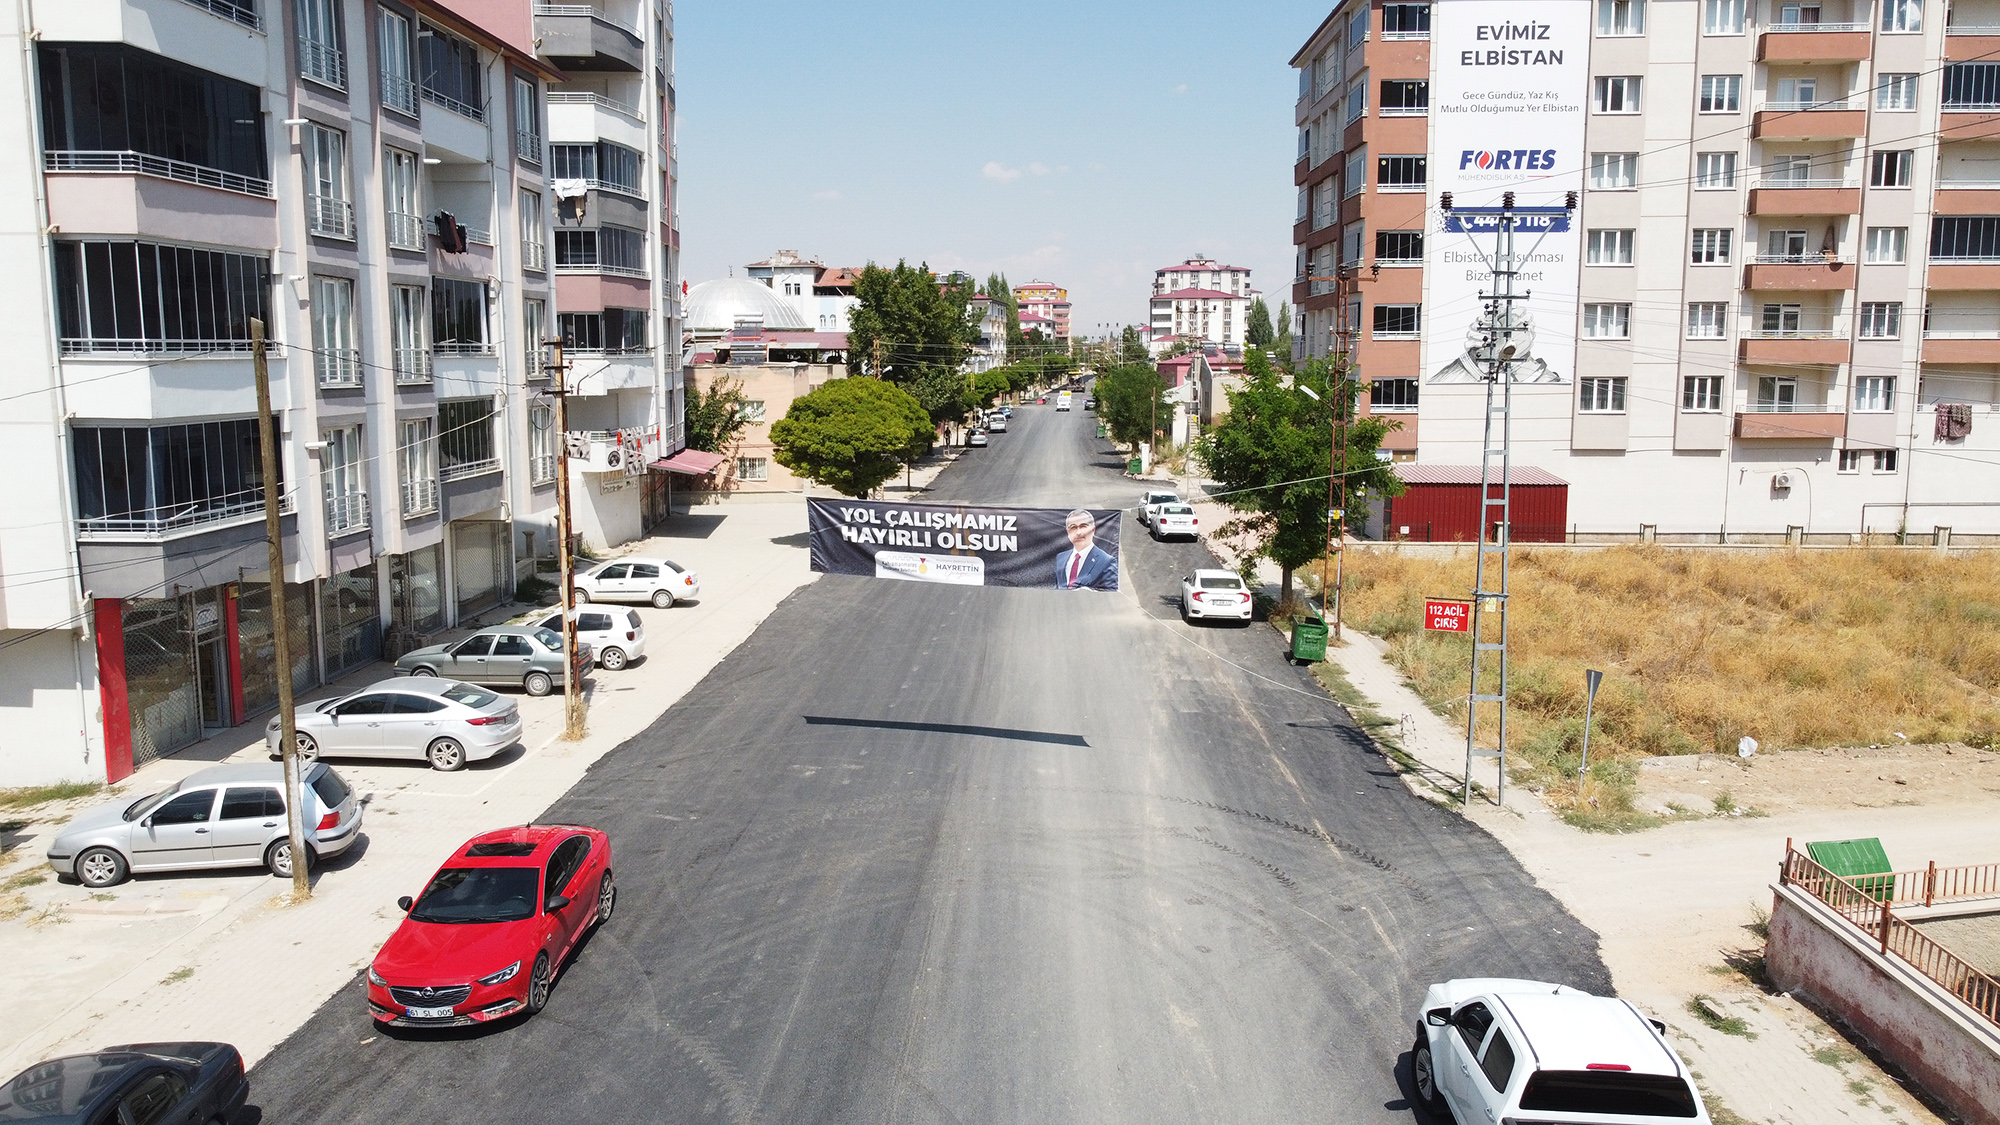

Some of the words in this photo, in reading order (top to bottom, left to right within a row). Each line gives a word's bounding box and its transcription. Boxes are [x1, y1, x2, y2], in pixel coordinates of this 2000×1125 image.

[1476, 20, 1551, 40] EVİMİZ
[1461, 45, 1564, 66] ELBİSTAN
[1462, 91, 1486, 100] Gece
[1488, 91, 1526, 100] Gündüz,
[1528, 91, 1543, 100] Yaz
[1546, 91, 1559, 101] Kış
[1440, 104, 1468, 114] Mutlu
[1470, 104, 1525, 114] Olduğumuz
[1526, 104, 1540, 113] Yer
[1543, 104, 1579, 113] Elbistan
[1459, 149, 1556, 170] FORTES
[1466, 270, 1492, 281] Bize
[840, 506, 881, 524] YOL
[884, 510, 1018, 532] ÇALIŞMAMIZ
[840, 525, 932, 548] HAYIRLI
[936, 532, 1018, 552] OLSUN
[936, 564, 980, 572] HAYRETTİN
[1428, 605, 1442, 616] 112
[1444, 604, 1466, 617] ACİL
[1434, 618, 1458, 630] ÇIKIŞ
[437, 1008, 452, 1016] 005
